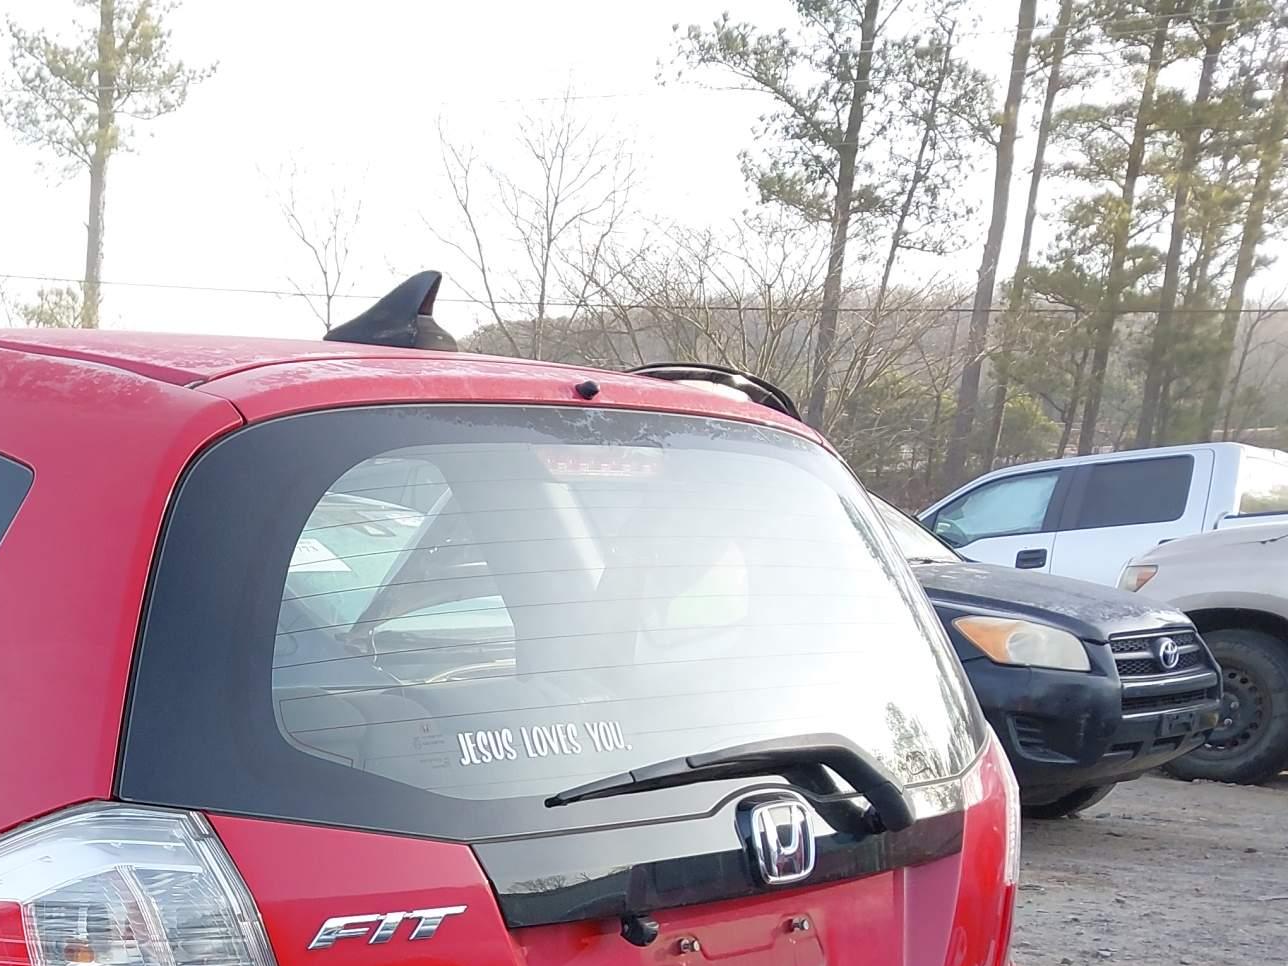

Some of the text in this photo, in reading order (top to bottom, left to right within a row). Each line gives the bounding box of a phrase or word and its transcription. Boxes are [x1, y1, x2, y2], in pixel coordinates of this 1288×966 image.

[458, 728, 517, 766] JESUS
[521, 722, 583, 758] LOVES
[584, 720, 633, 752] YOU.
[307, 904, 469, 951] FIT
